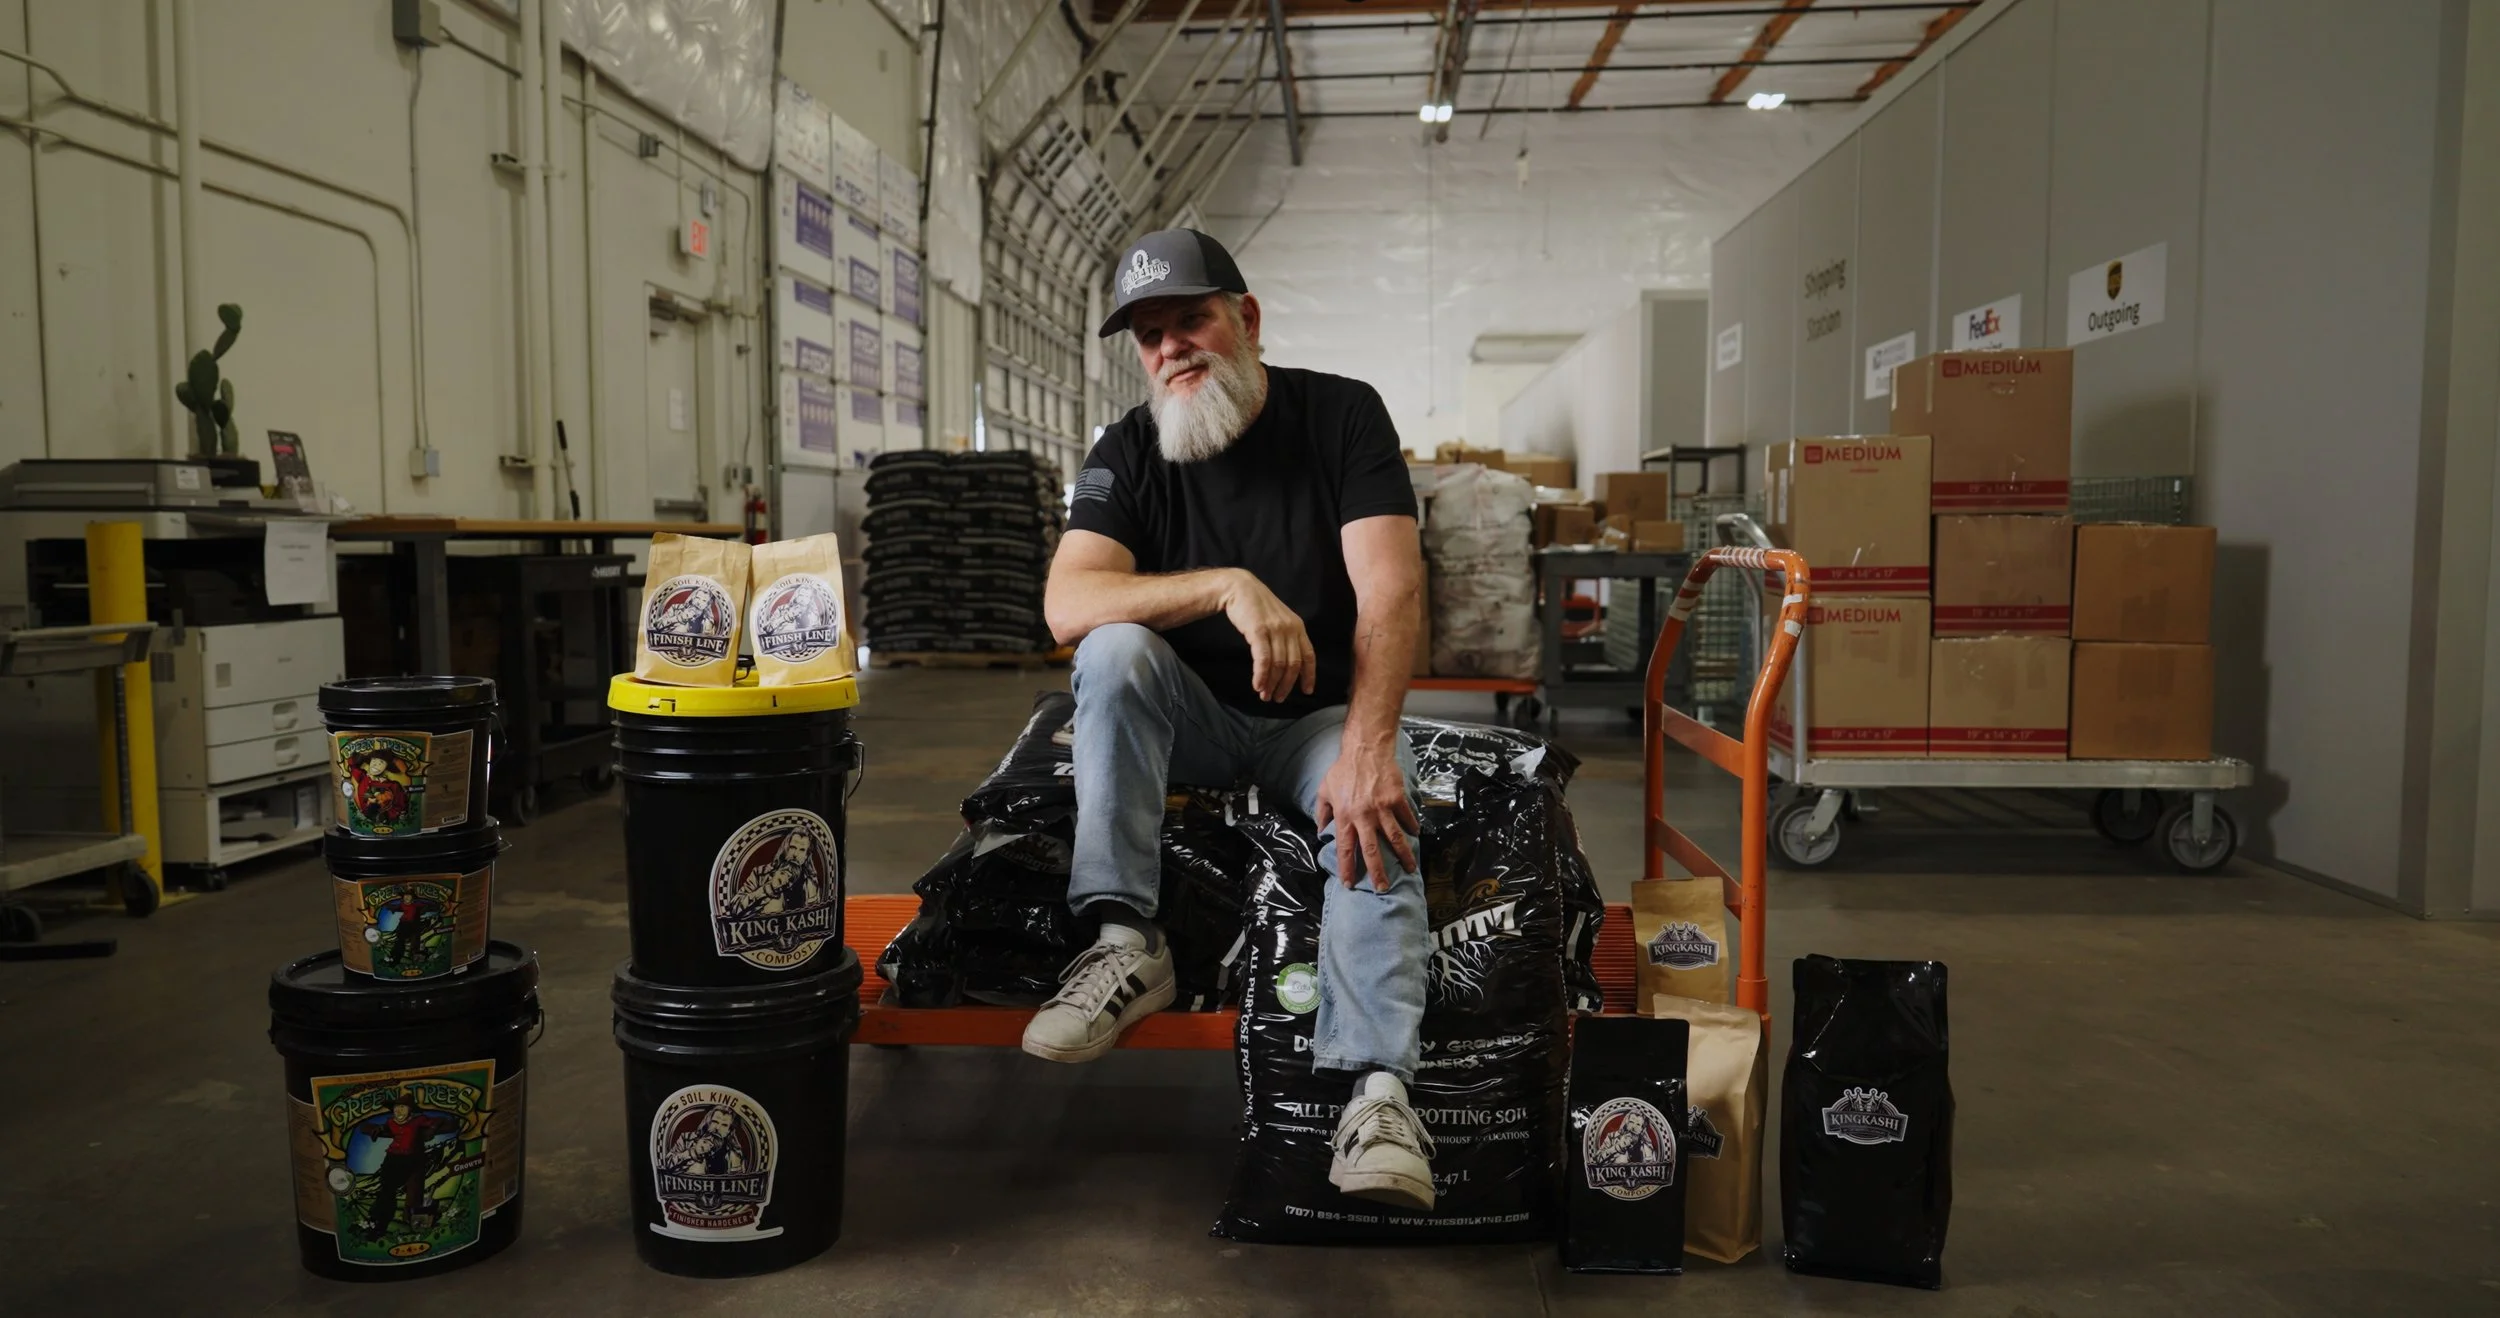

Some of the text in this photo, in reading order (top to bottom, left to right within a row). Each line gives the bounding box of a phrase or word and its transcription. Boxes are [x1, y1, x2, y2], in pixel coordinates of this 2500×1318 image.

[1804, 258, 1846, 300] Shipping
[1969, 307, 2001, 340] FedEx
[2088, 301, 2140, 332] Outgoing
[1964, 359, 2041, 375] MEDIUM
[1825, 446, 1901, 461] MEDIUM
[673, 578, 716, 592] SOIL KING
[775, 579, 792, 591] SOIL
[1826, 608, 1901, 623] MEDIUM
[653, 633, 724, 653] FINISH LINE
[765, 629, 831, 649] FINISH LINE
[728, 908, 830, 945] KING KASHI
[755, 942, 814, 964] COMPOST
[1654, 943, 1713, 956] KINGKASHI
[1251, 944, 1260, 974] ALL
[330, 1086, 400, 1128] GREEN
[406, 1083, 474, 1114] TREES
[680, 1091, 739, 1108] SOIL KING
[1293, 1104, 1324, 1119] ALL
[1415, 1107, 1493, 1126] POTTING
[1495, 1107, 1529, 1124] SOIL
[1830, 1113, 1900, 1131] KINGKASHI
[453, 1158, 483, 1173] GROWTH
[1595, 1165, 1667, 1183] KING KASHI
[664, 1174, 759, 1196] FINISH LINE
[1433, 1169, 1471, 1184] 2.47 L
[1611, 1186, 1651, 1197] COMPOST
[672, 1211, 749, 1228] FINISHER HARDENER
[1285, 1204, 1530, 1226] (707) 894-3500 WWW.THESOILKING.COM
